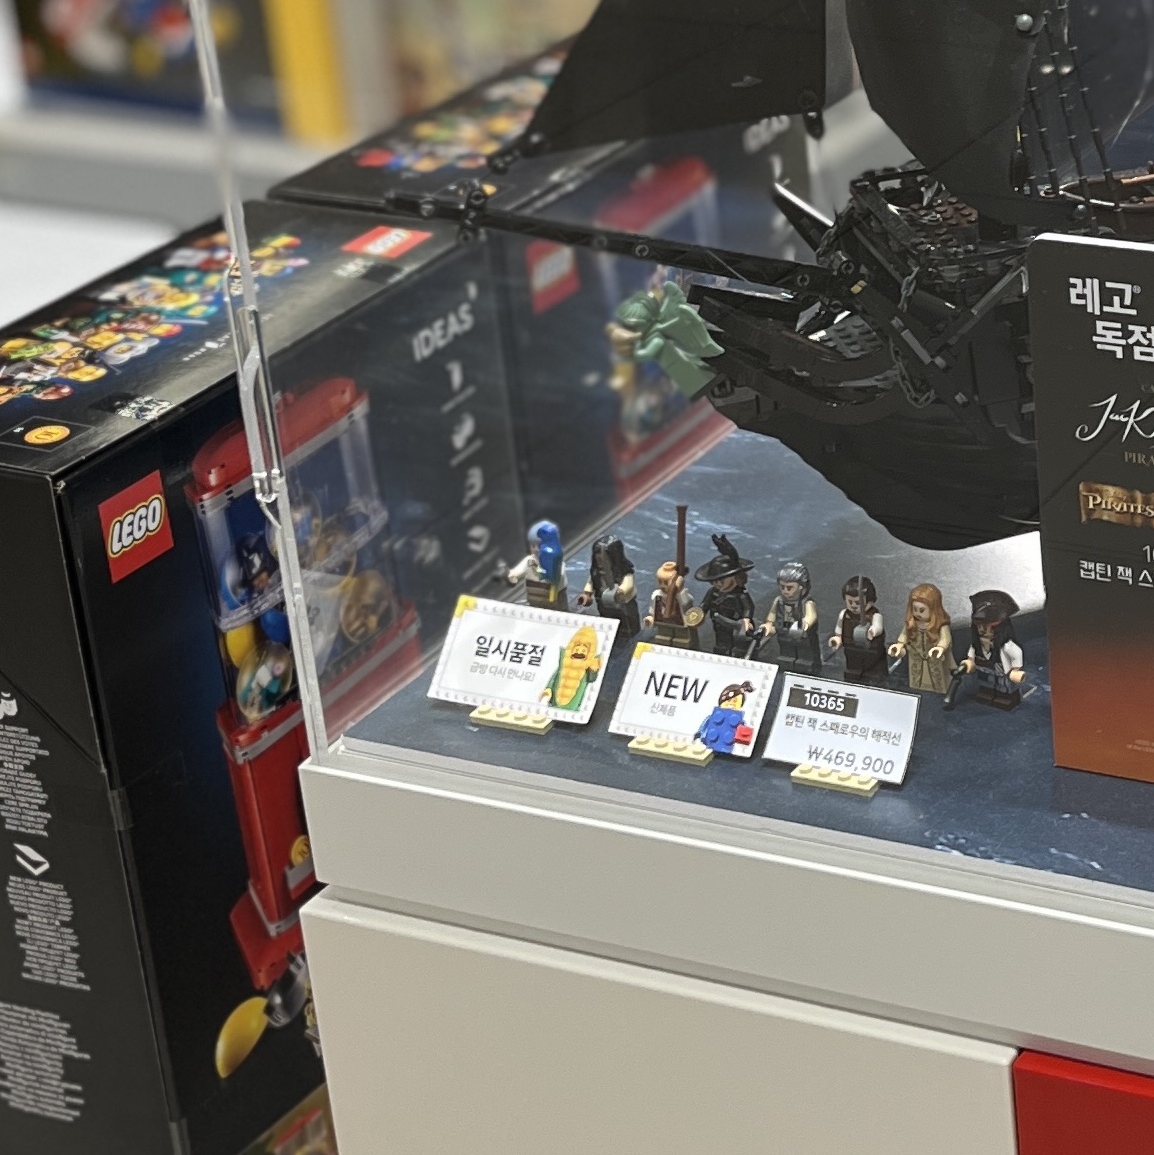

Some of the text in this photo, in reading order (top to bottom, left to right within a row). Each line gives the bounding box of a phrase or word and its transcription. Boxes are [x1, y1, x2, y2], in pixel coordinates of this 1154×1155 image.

[411, 302, 475, 362] IDEAS
[110, 497, 163, 554] LEGO
[1079, 560, 1112, 582] 캡틴
[1117, 566, 1133, 585] 잭
[475, 635, 547, 666] 일시품절
[644, 671, 709, 704] NEW
[804, 692, 845, 712] 10365
[650, 703, 677, 717] 신제품
[807, 717, 818, 731] 잭
[807, 745, 895, 775] ₩469,900
